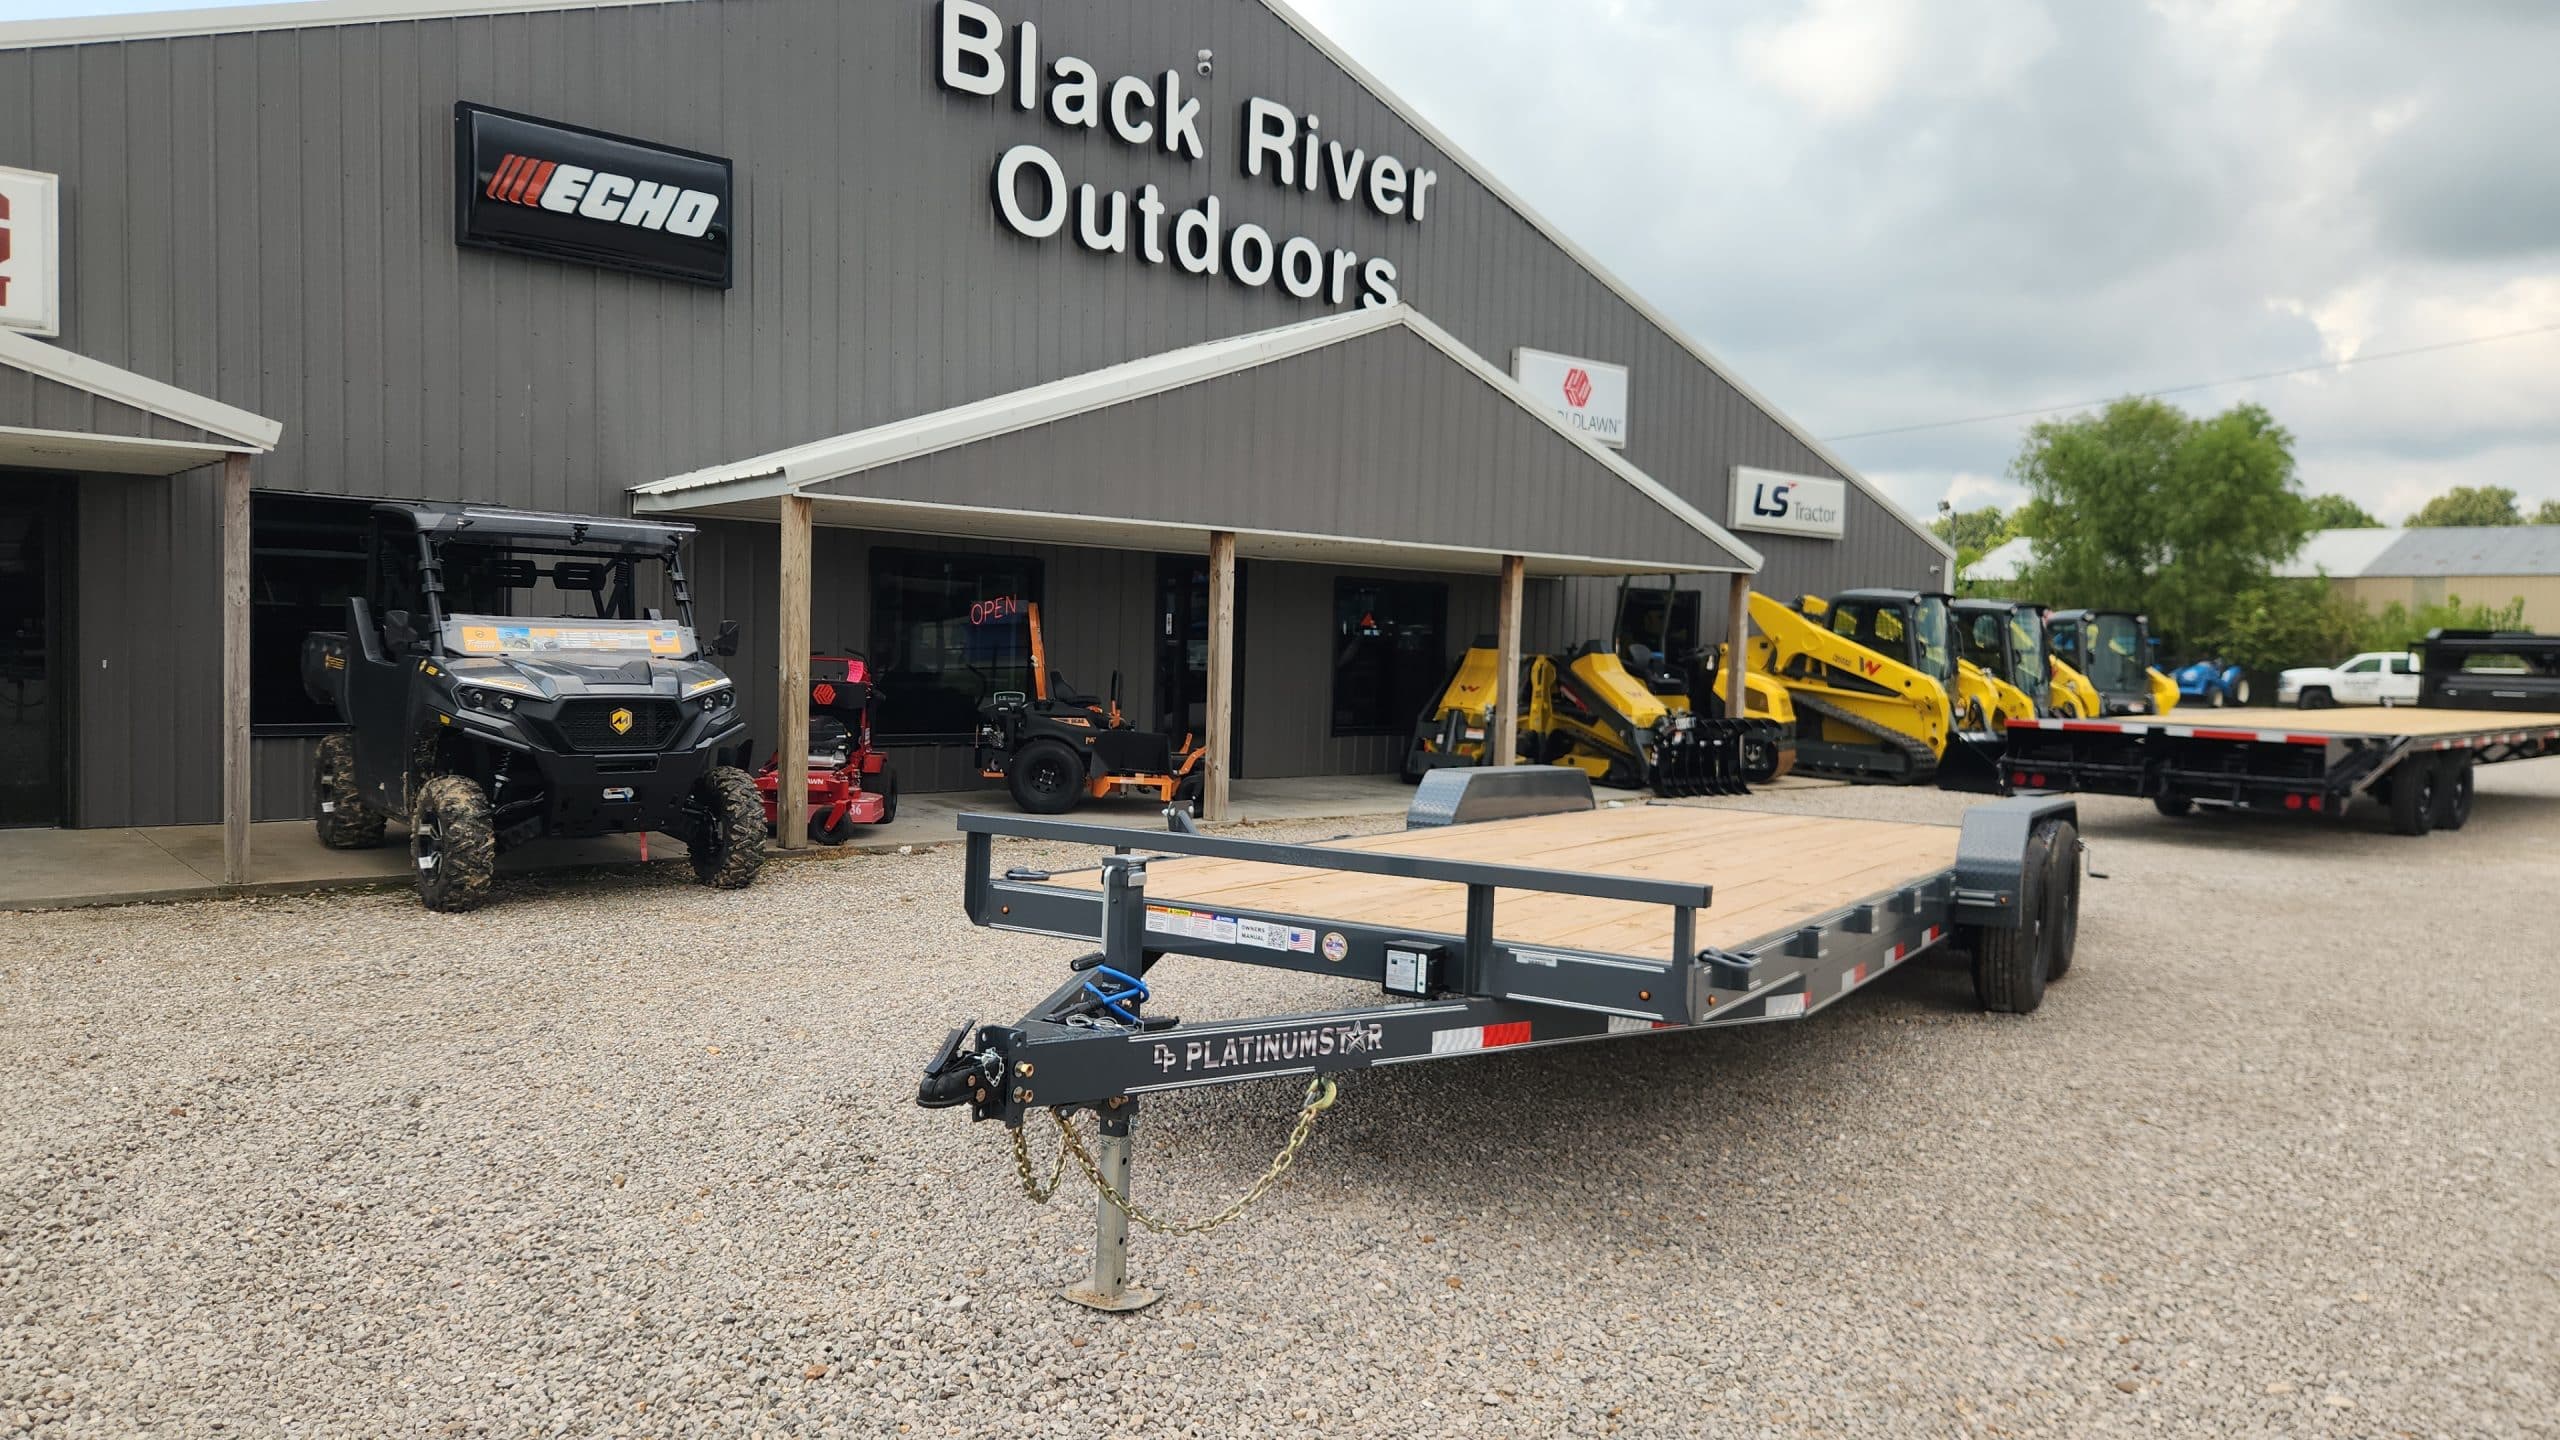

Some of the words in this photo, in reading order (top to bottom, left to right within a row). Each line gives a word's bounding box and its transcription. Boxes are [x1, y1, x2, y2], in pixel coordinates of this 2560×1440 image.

[942, 0, 1204, 160] Black
[1248, 97, 1437, 222] River
[540, 164, 720, 238] ECHO
[997, 145, 1399, 309] Outdoors
[1753, 483, 1789, 517] LS
[1794, 502, 1837, 523] Tractor
[970, 595, 1017, 625] OPEN
[1241, 924, 1265, 933] OWNERS
[1241, 932, 1264, 941] MANUAL
